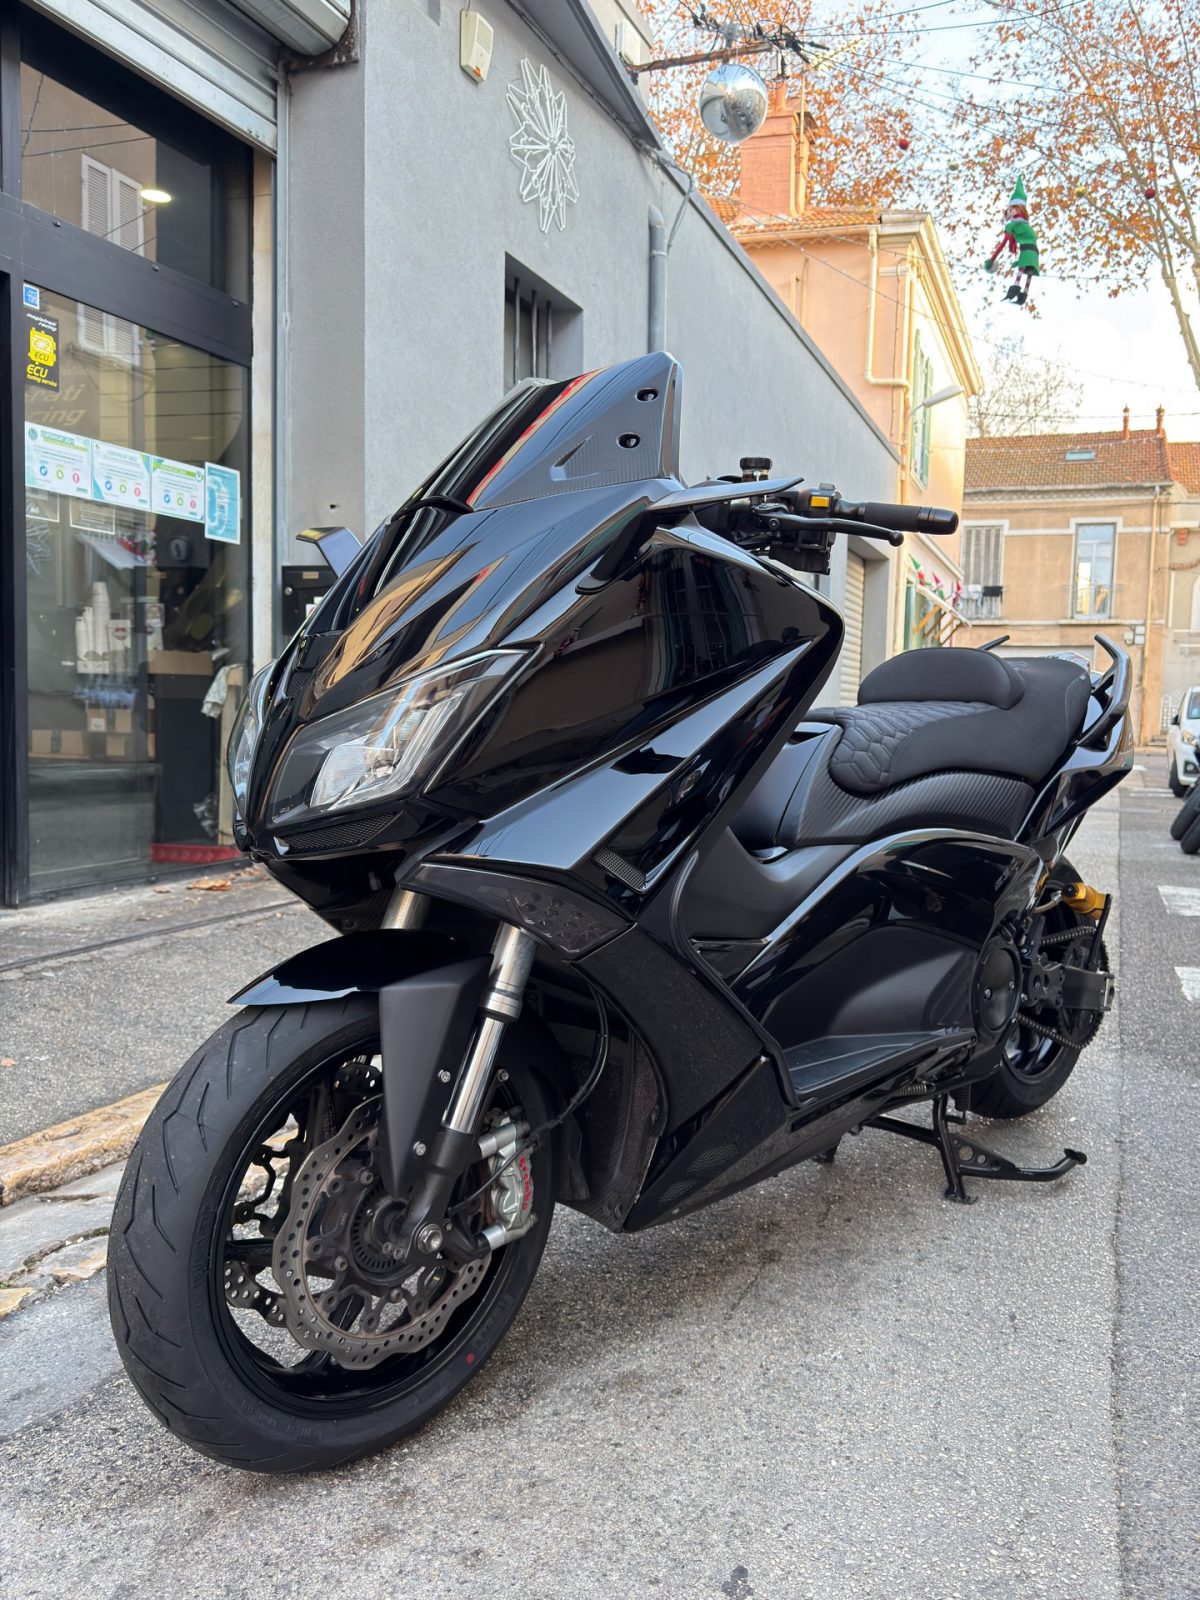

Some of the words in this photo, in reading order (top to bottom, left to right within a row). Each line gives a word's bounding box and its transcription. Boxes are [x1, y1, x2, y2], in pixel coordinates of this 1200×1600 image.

[38, 322, 57, 332] racing
[35, 352, 49, 362] ECU
[26, 364, 49, 378] ECU
[27, 374, 41, 383] tuning
[41, 378, 57, 387] service
